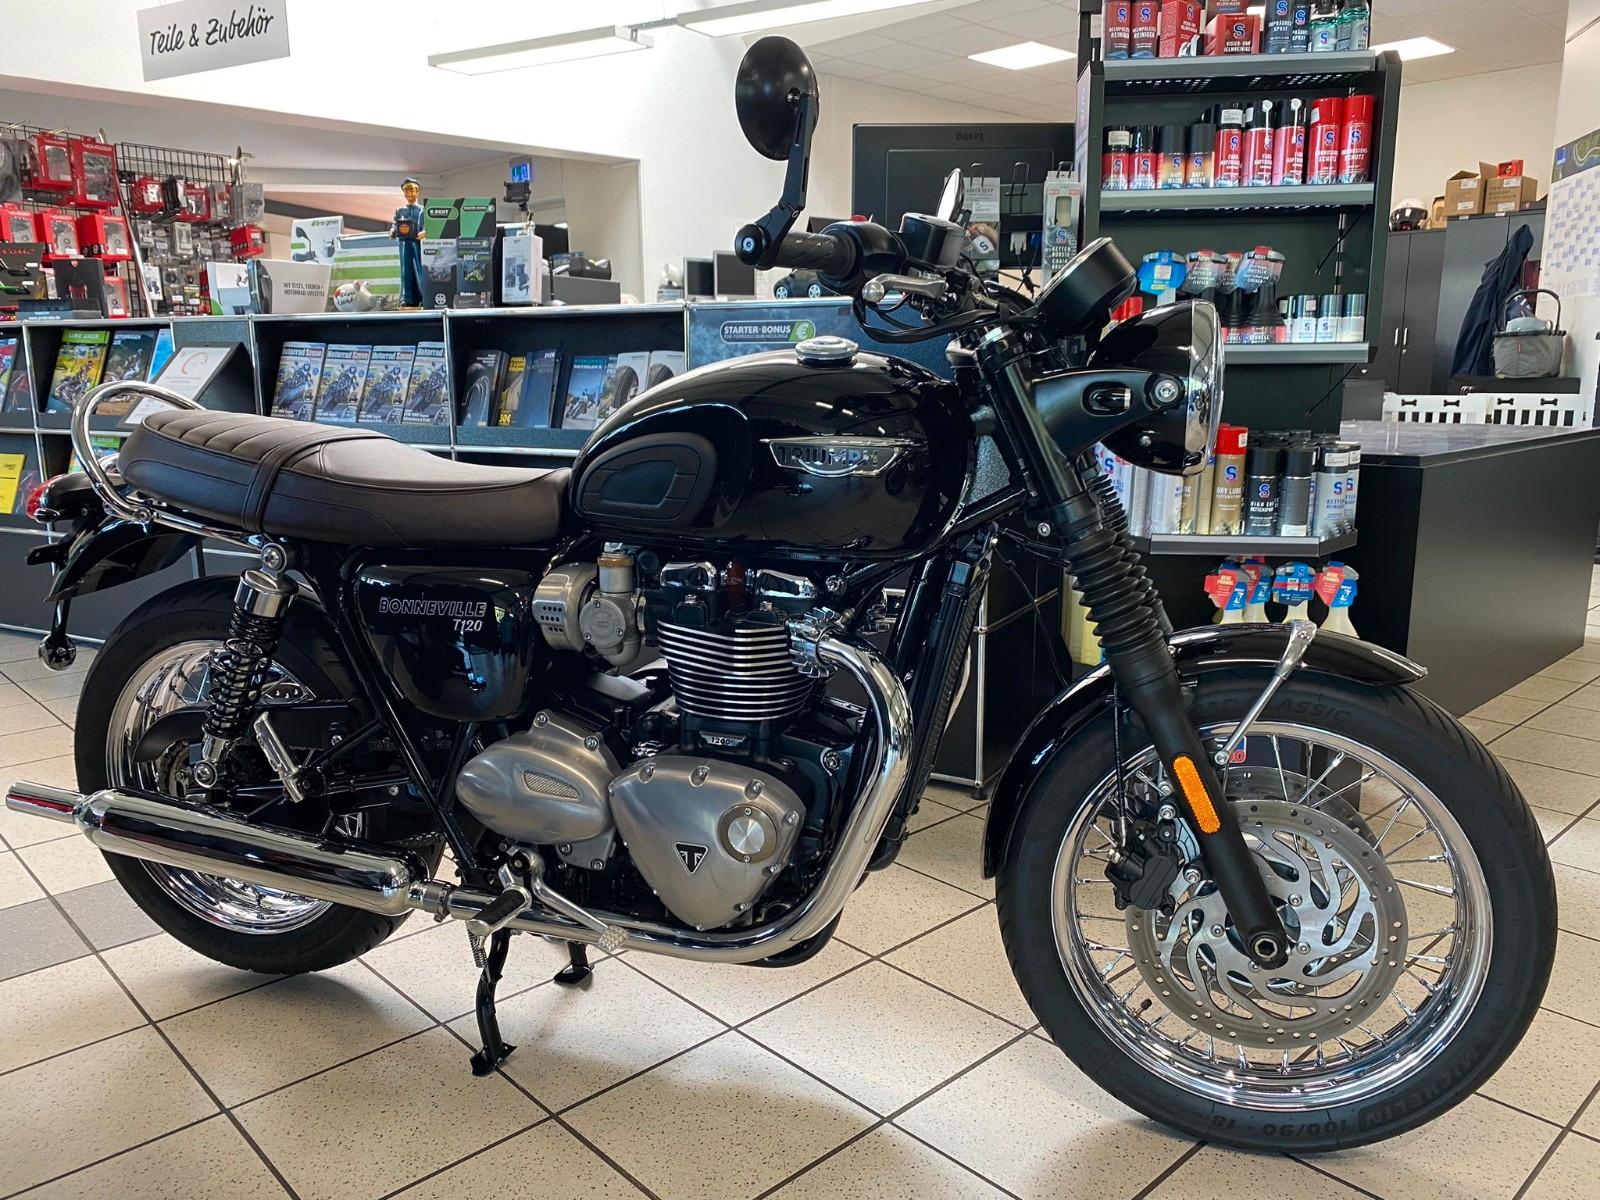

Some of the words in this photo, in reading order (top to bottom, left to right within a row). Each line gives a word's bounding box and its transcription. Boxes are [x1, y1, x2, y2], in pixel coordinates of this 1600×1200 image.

[150, 23, 185, 55] Teile
[189, 23, 199, 47] &
[205, 5, 274, 45] Zubehör
[379, 597, 487, 617] BONNEVILLE
[453, 619, 482, 632] T120
[711, 737, 732, 746] 1200
[1261, 1118, 1351, 1137] 100/90
